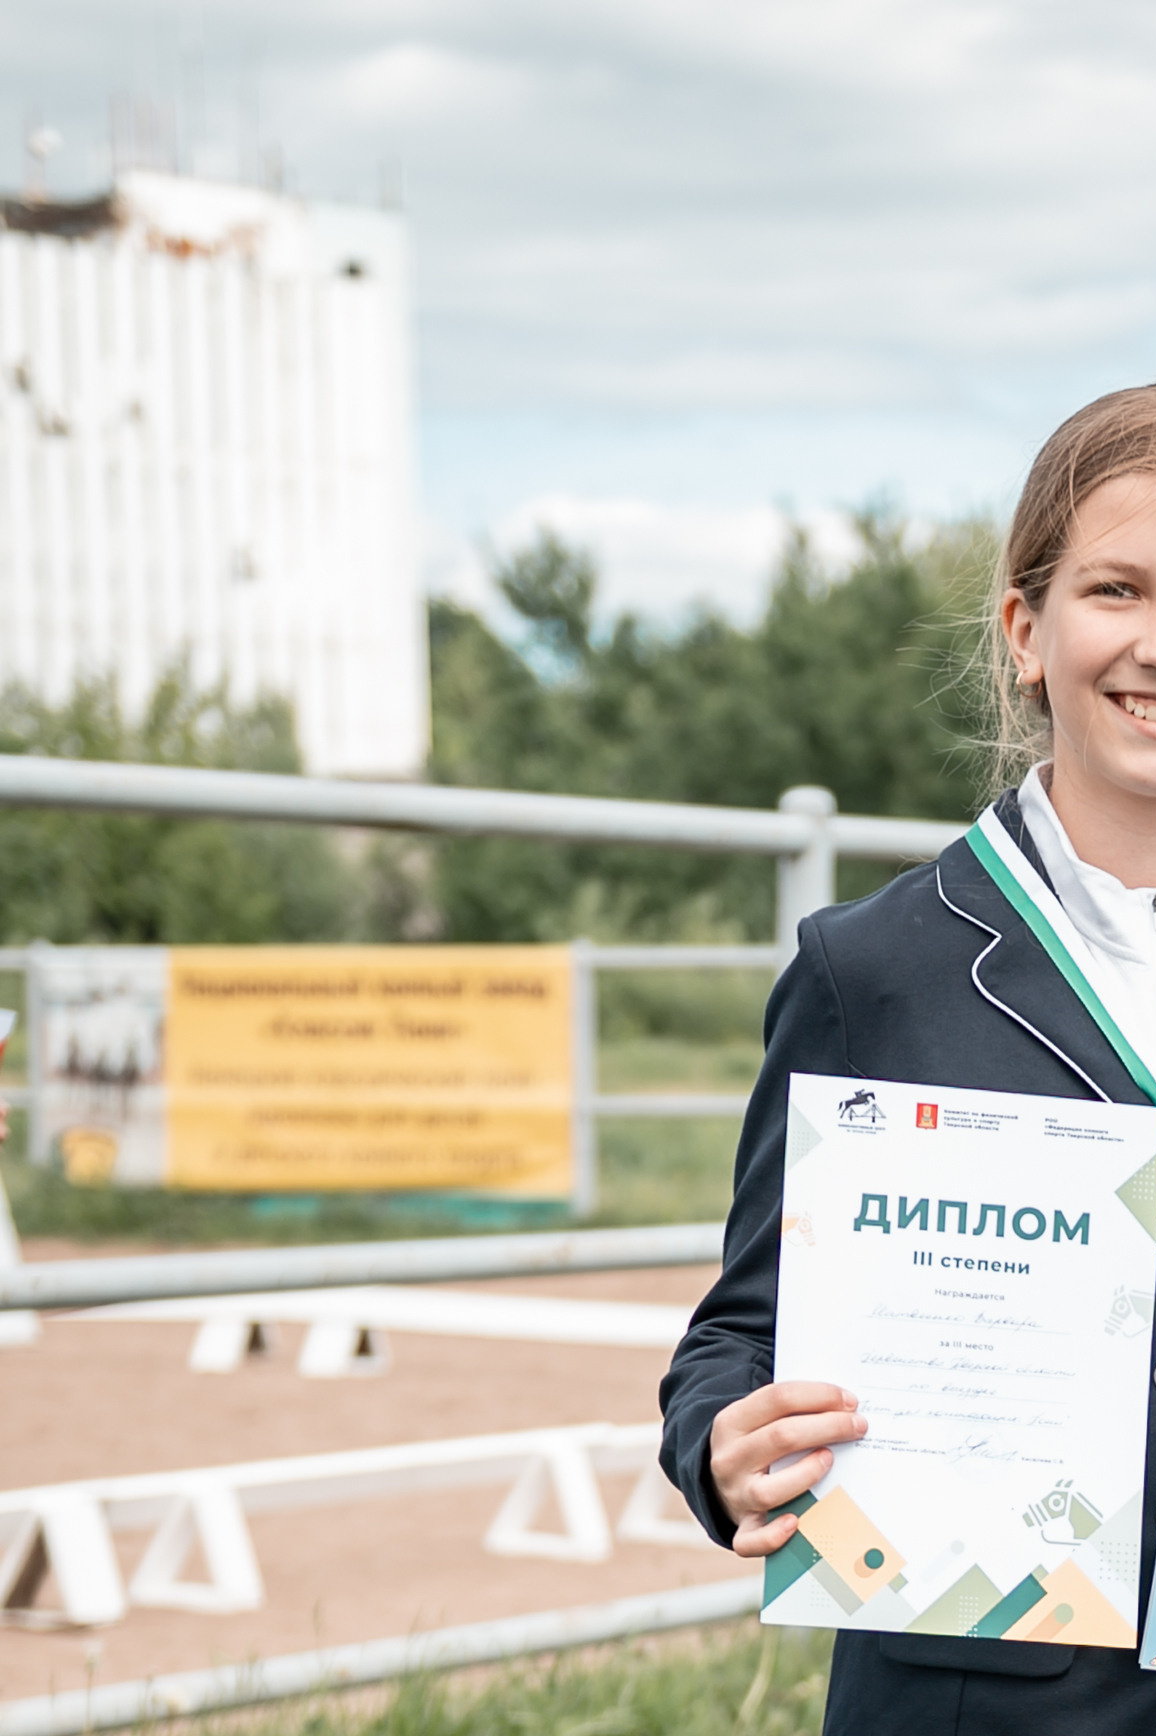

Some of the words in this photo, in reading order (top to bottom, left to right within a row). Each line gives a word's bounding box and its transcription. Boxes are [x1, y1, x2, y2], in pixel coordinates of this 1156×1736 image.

[853, 1193, 1091, 1245] ДИПЛОМ
[913, 1251, 933, 1266] III
[940, 1255, 1030, 1275] степени
[934, 1288, 1005, 1301] Награждается
[939, 1340, 950, 1348] за
[965, 1342, 994, 1351] место
